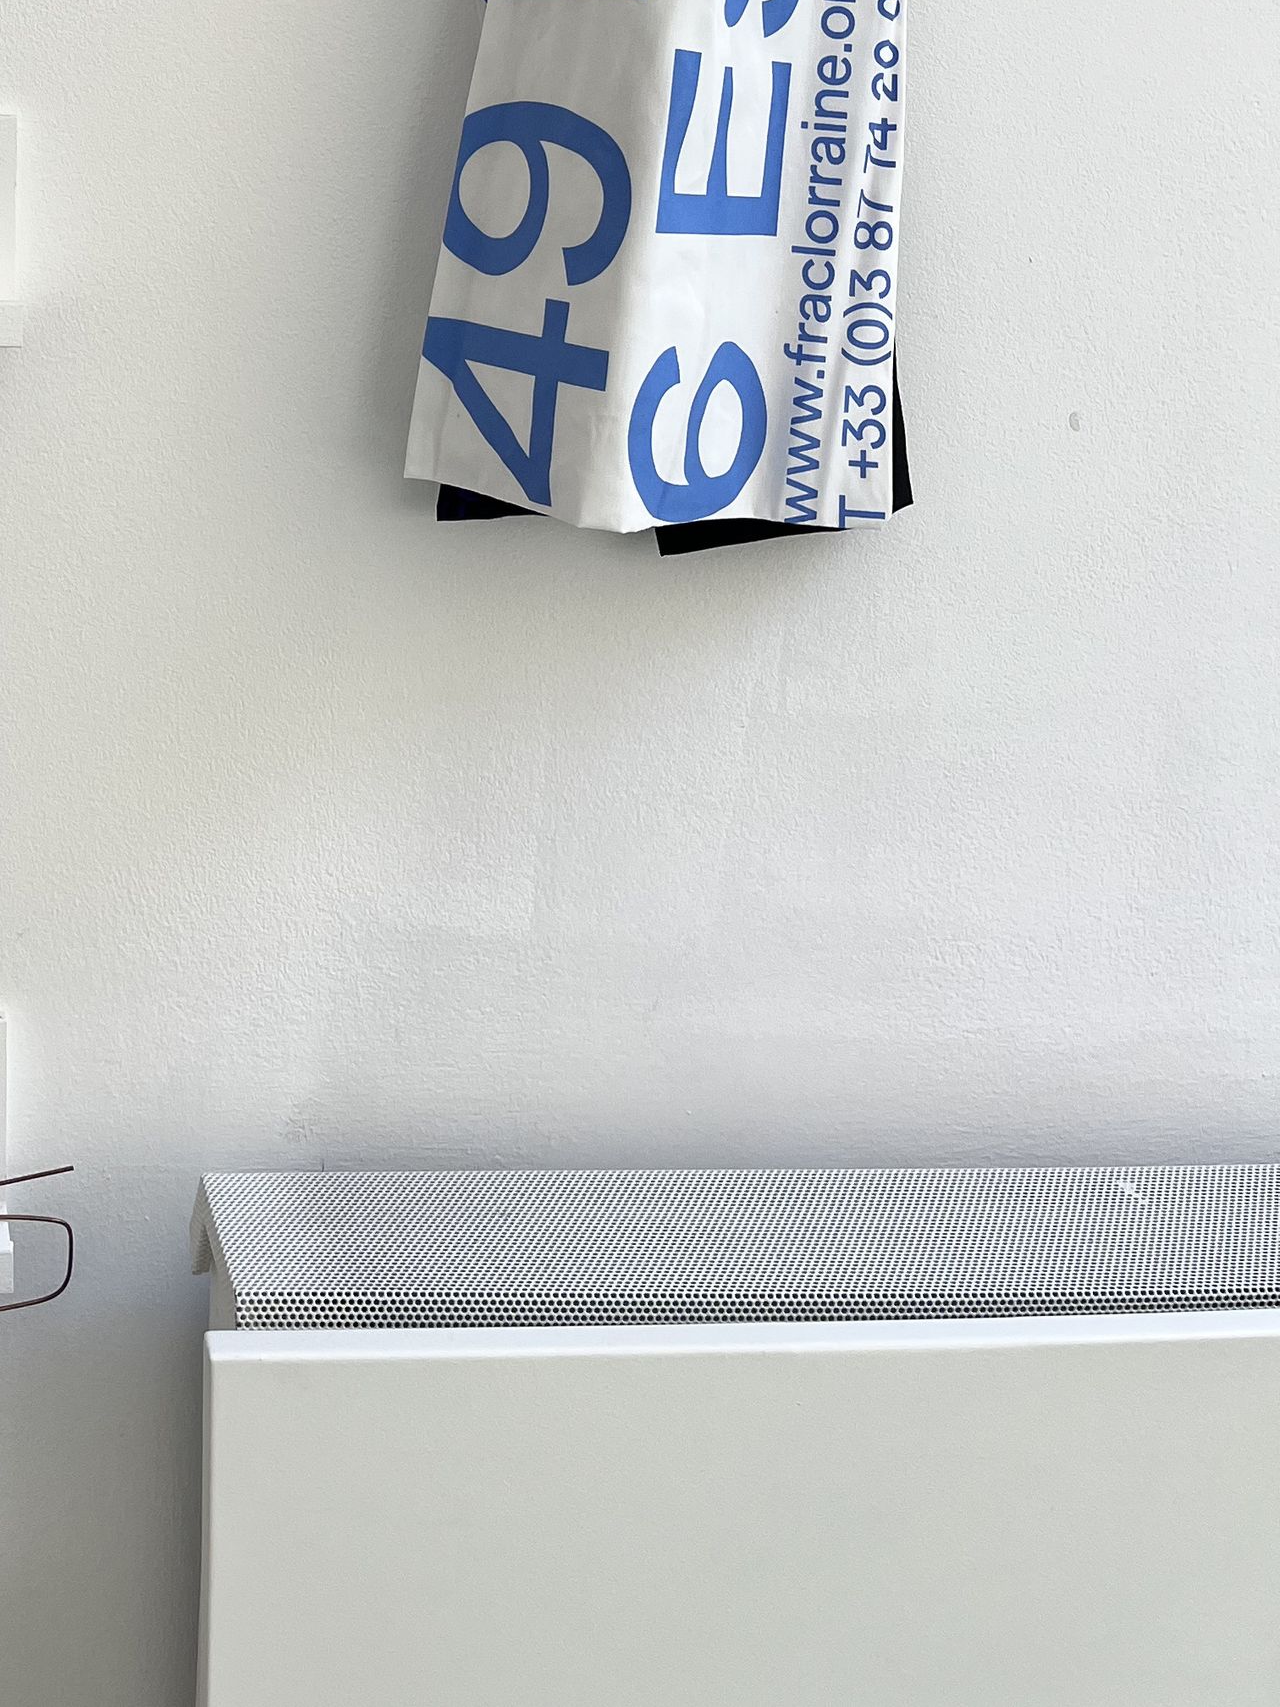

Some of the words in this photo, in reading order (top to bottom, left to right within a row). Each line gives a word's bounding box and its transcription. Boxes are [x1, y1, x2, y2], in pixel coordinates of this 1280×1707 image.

[853, 189, 895, 251] 87
[422, 101, 632, 507] 49
[841, 268, 895, 364] (0)3
[628, 341, 768, 523] 6
[840, 384, 886, 479] +33
